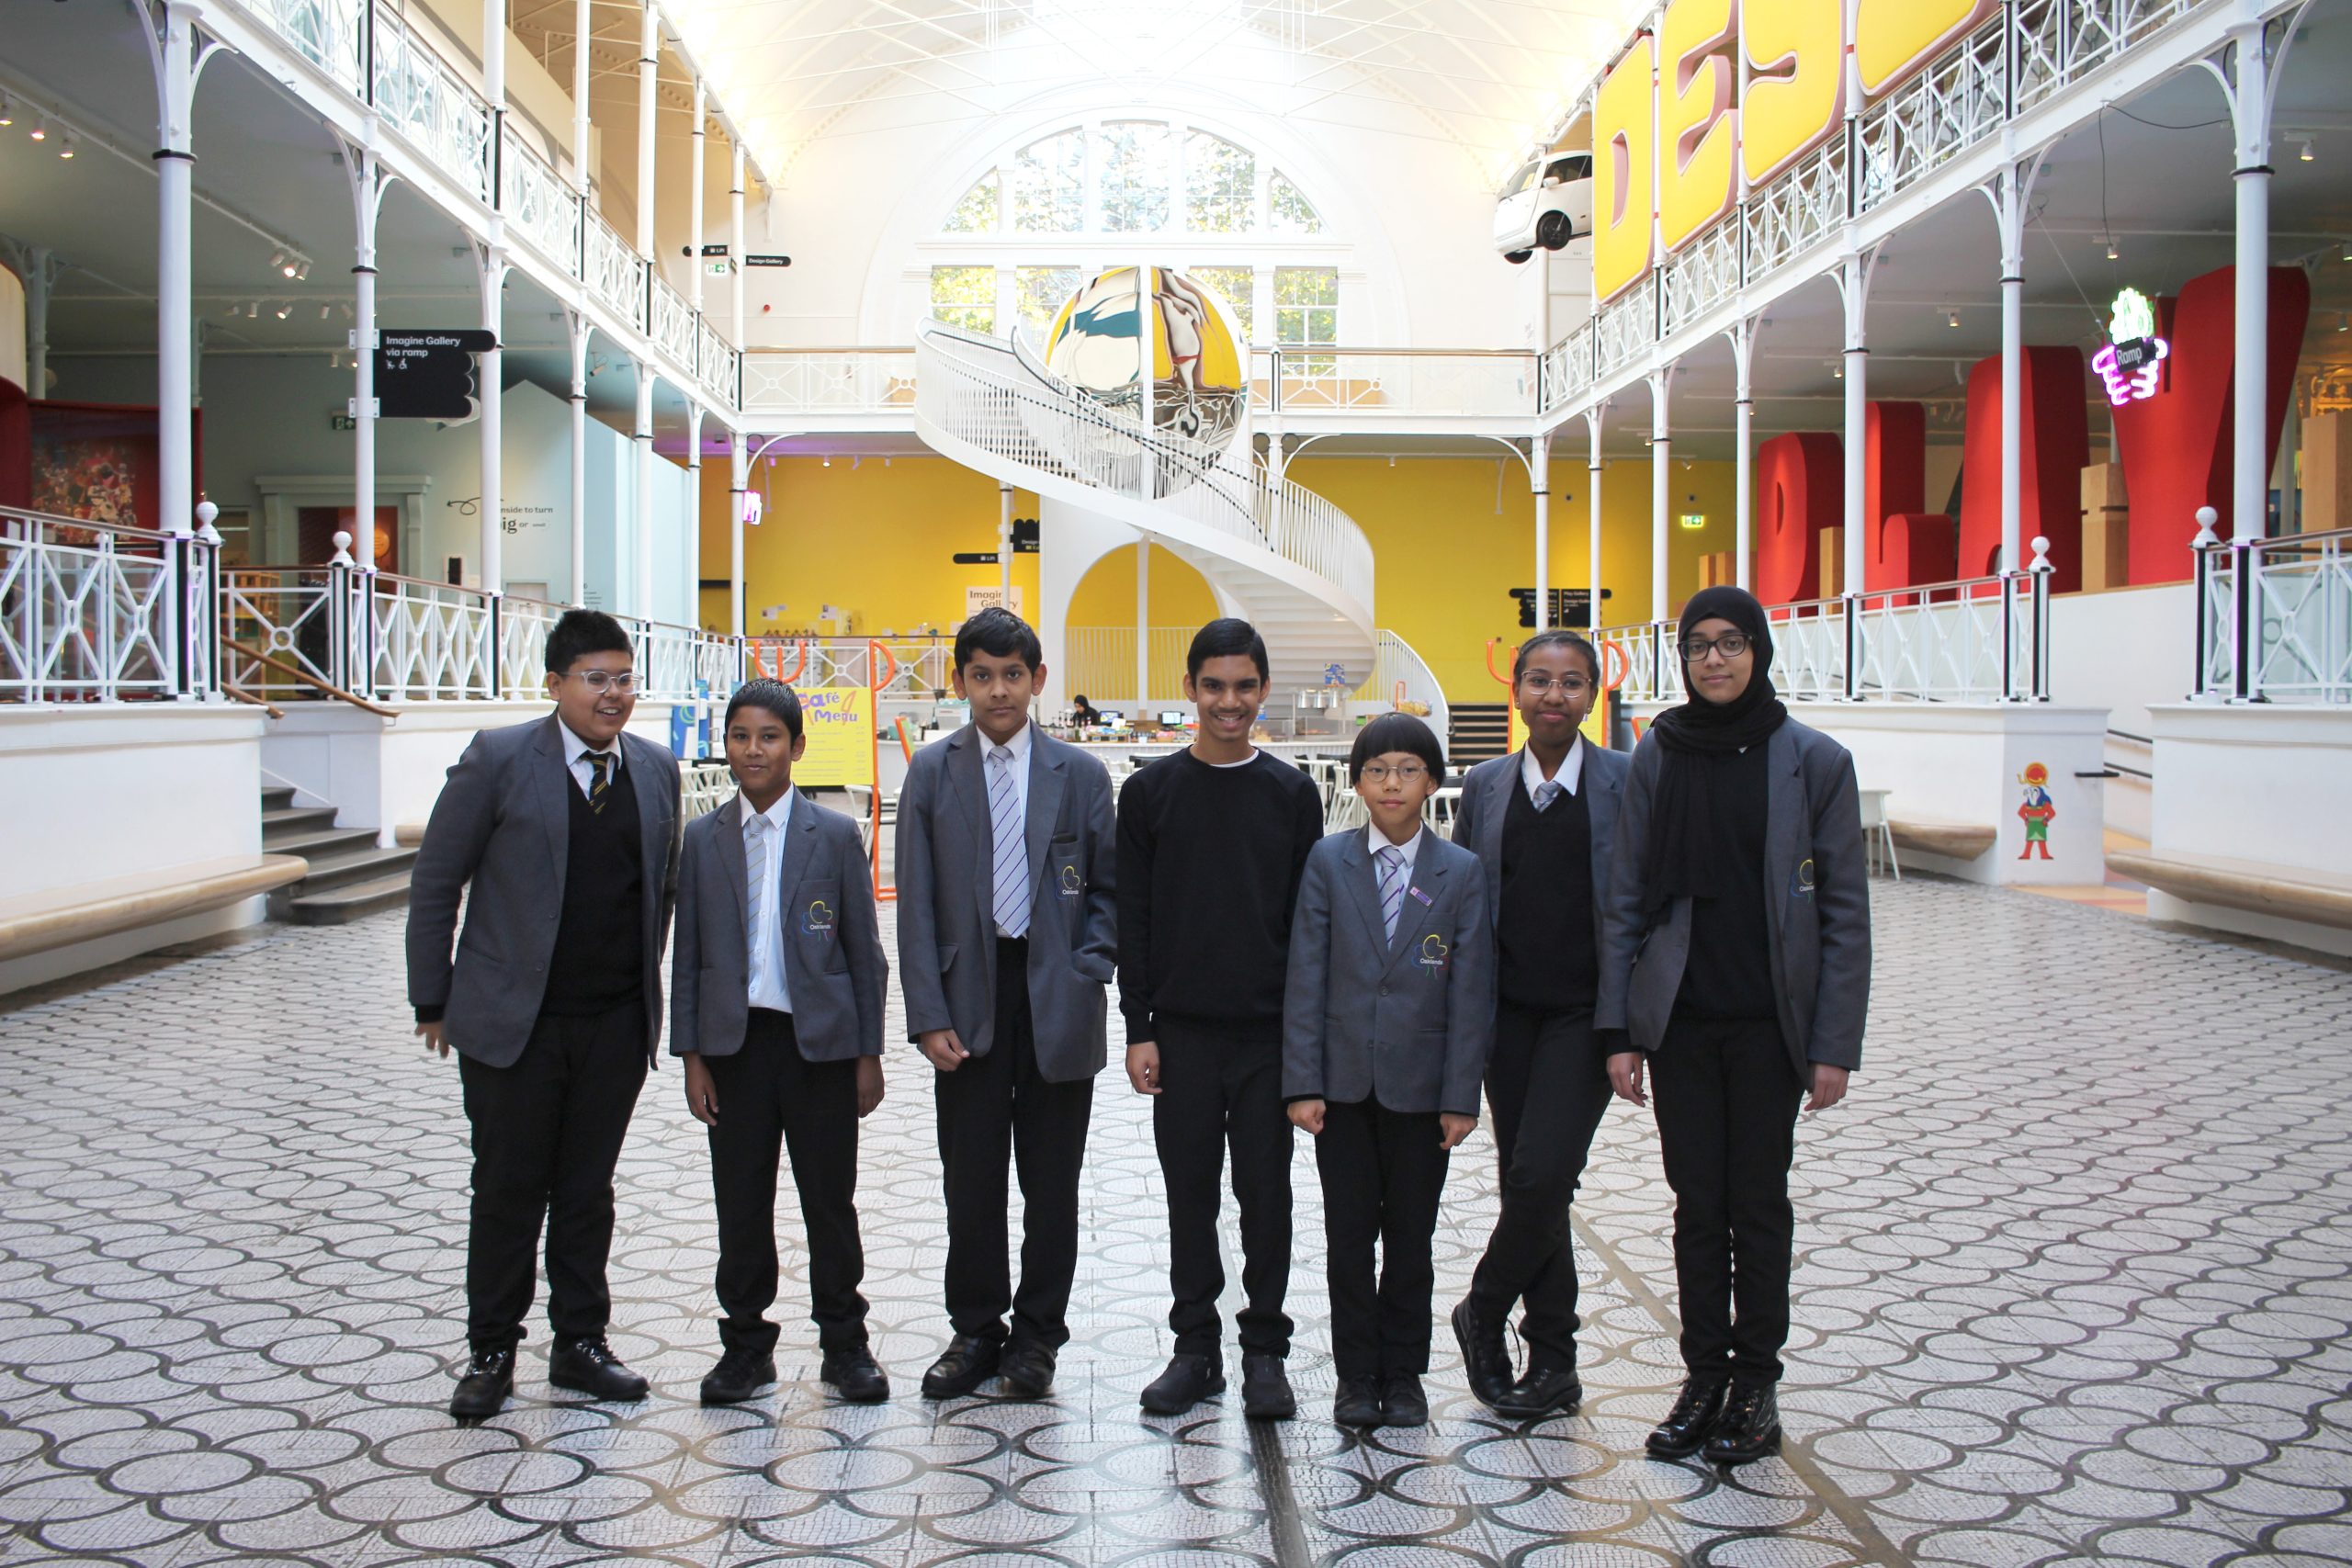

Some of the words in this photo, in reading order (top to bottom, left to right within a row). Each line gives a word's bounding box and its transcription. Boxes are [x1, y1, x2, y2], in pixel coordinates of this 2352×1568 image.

[1594, 0, 2007, 305] DES
[386, 336, 424, 346] Imagine
[425, 336, 461, 347] Gallery
[386, 348, 400, 356] via
[401, 349, 429, 358] ramp
[2116, 347, 2143, 366] Ramp
[1757, 265, 2311, 620] PLAY
[501, 516, 517, 534] ig
[970, 591, 1002, 600] Imagi
[980, 600, 1018, 610] Gally
[814, 709, 858, 723] Menu
